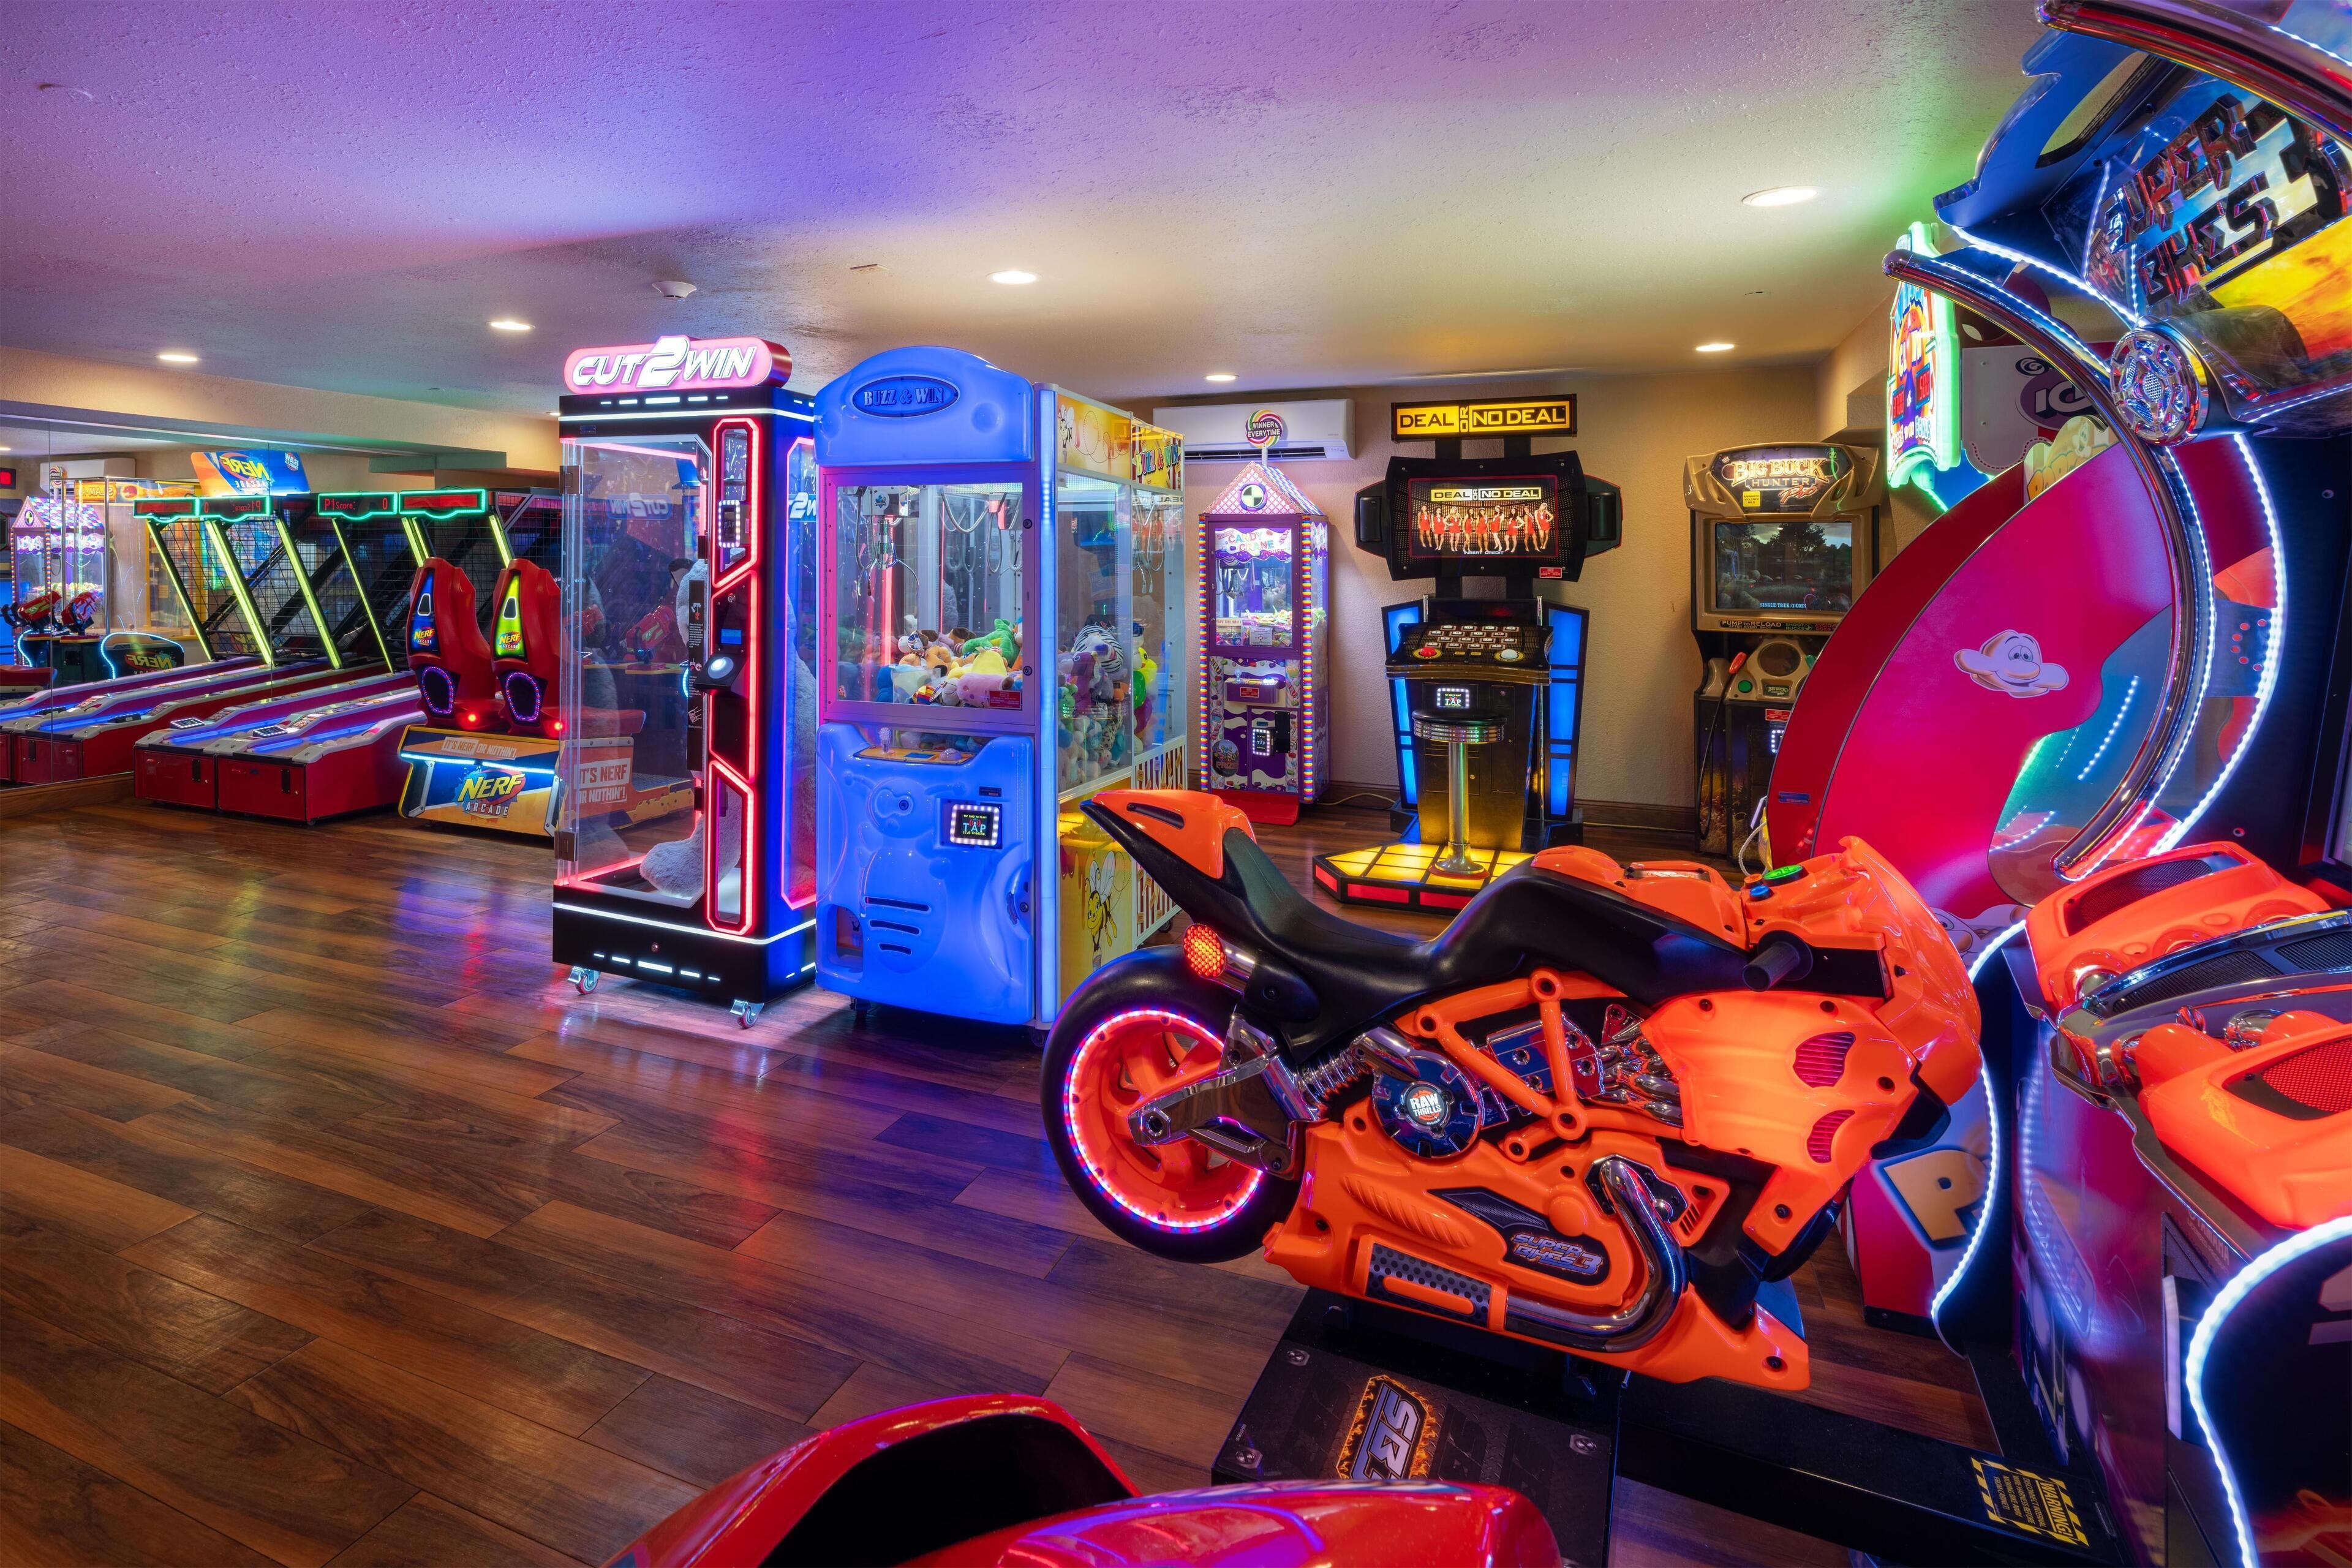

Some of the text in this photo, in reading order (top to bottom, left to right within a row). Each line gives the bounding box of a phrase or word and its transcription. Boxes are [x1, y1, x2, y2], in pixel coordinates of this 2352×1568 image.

[864, 386, 944, 407] BUZZ & WIN
[1400, 405, 1566, 432] DEAL OR NO DEAL
[1247, 429, 1280, 438] EVERYTIME
[1915, 415, 1931, 442] BONUS
[1136, 443, 1178, 477] BUZZ & WIN
[1732, 459, 1830, 487] BIG BUCK
[1752, 478, 1810, 487] HUNTER
[1473, 489, 1478, 500] OR
[1778, 485, 1817, 504] Pro
[1228, 532, 1264, 543] CANDY
[1239, 540, 1274, 552] CRANE
[414, 628, 435, 639] NERF
[499, 633, 521, 645] NERF
[444, 740, 457, 748] IT'S
[458, 741, 475, 750] NERF
[477, 744, 486, 753] OR
[600, 764, 627, 782] NERF
[458, 773, 526, 802] NERF
[589, 786, 625, 803] NOTHIN'!
[466, 801, 508, 816] ARCADE
[963, 821, 986, 832] TAP
[1410, 1093, 1439, 1109] RAW
[1412, 1104, 1442, 1117] THRILLS
[1513, 1234, 1583, 1256] SUPER
[1514, 1246, 1578, 1264] BIKES
[2022, 1477, 2046, 1528] DISCONNECT INTERNAL
[2039, 1482, 2074, 1537] WARNING!
[2023, 1506, 2035, 1525] BEFORE
